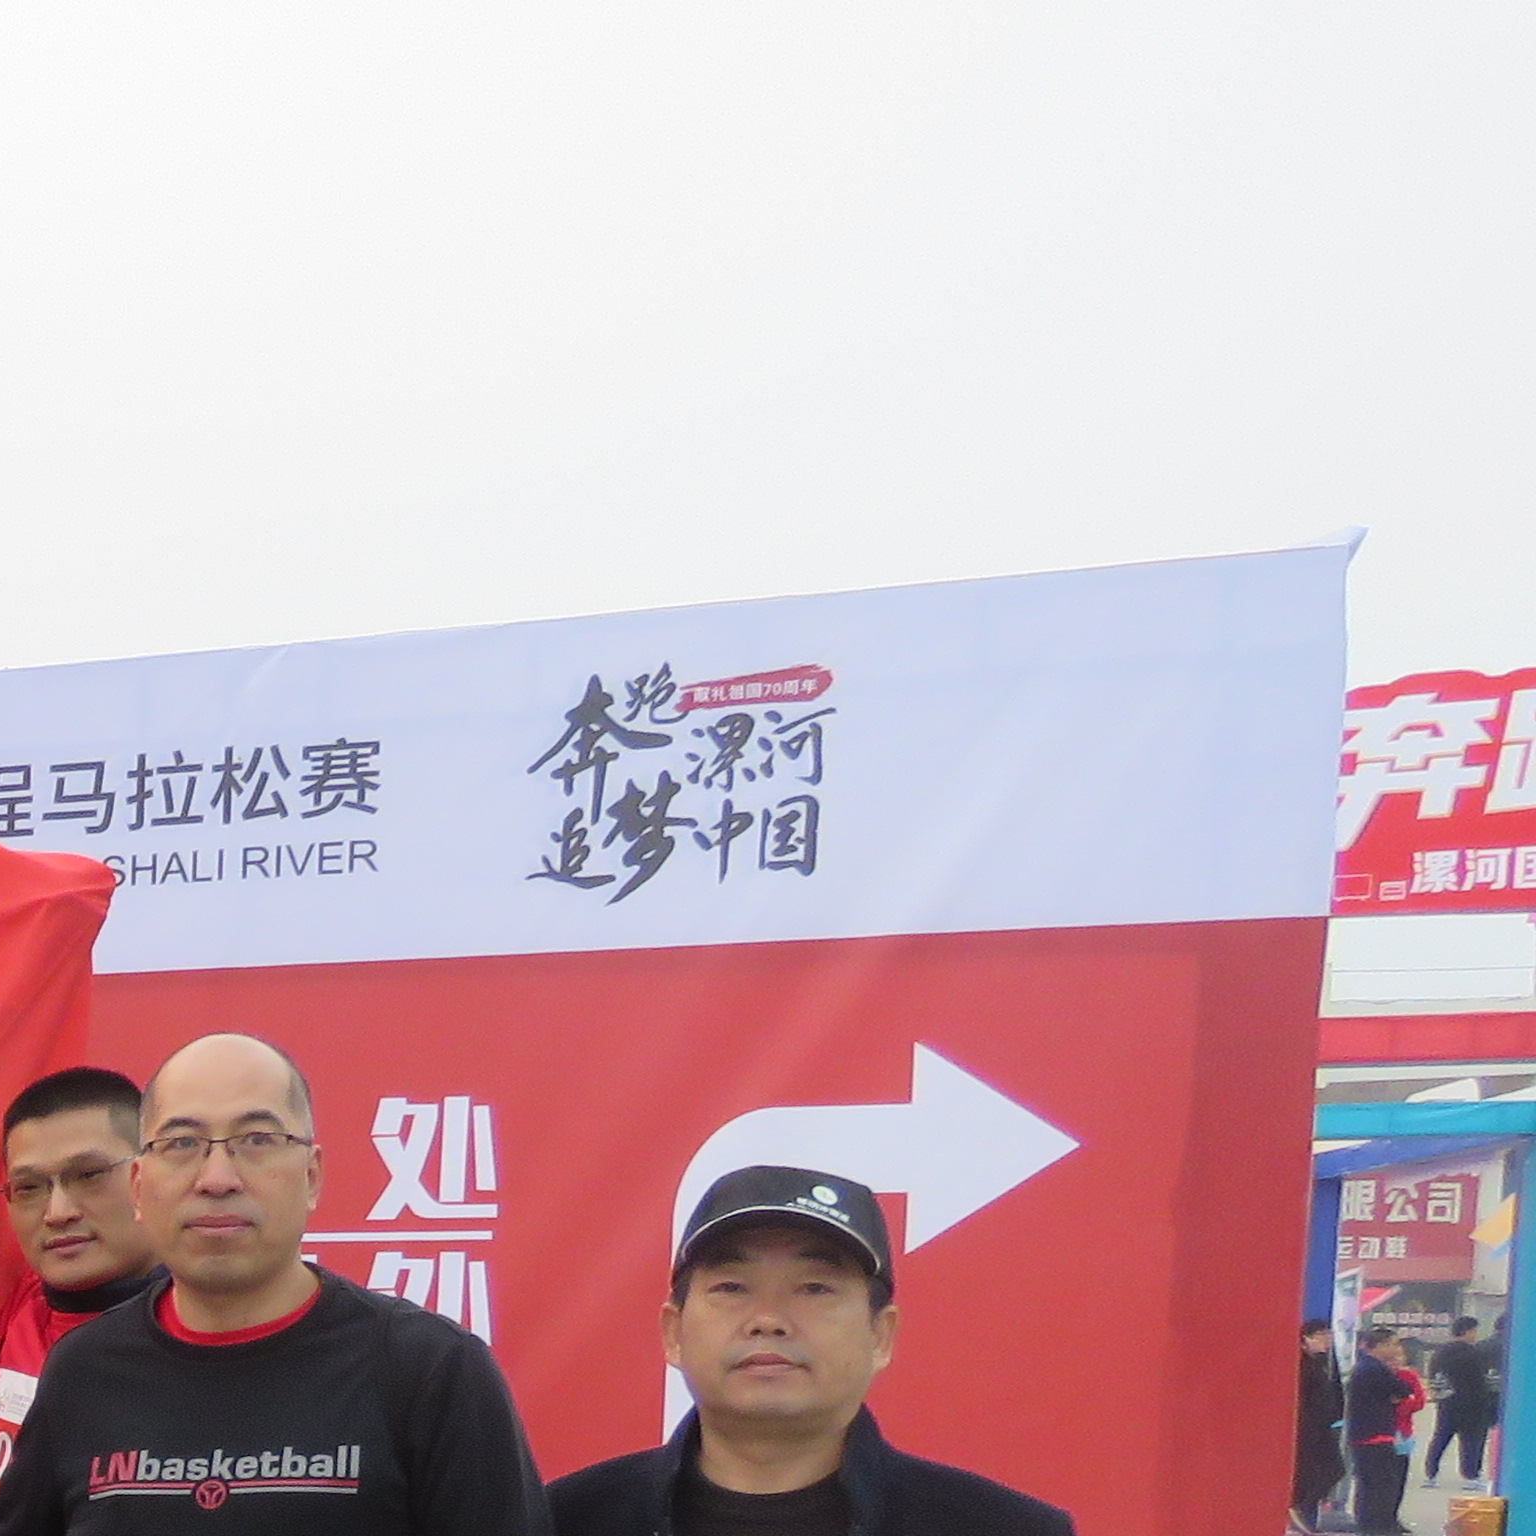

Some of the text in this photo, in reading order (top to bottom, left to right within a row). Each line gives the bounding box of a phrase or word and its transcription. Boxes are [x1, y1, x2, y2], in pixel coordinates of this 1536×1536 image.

[103, 839, 379, 888] SHALI RIVER
[365, 1095, 499, 1221] 处
